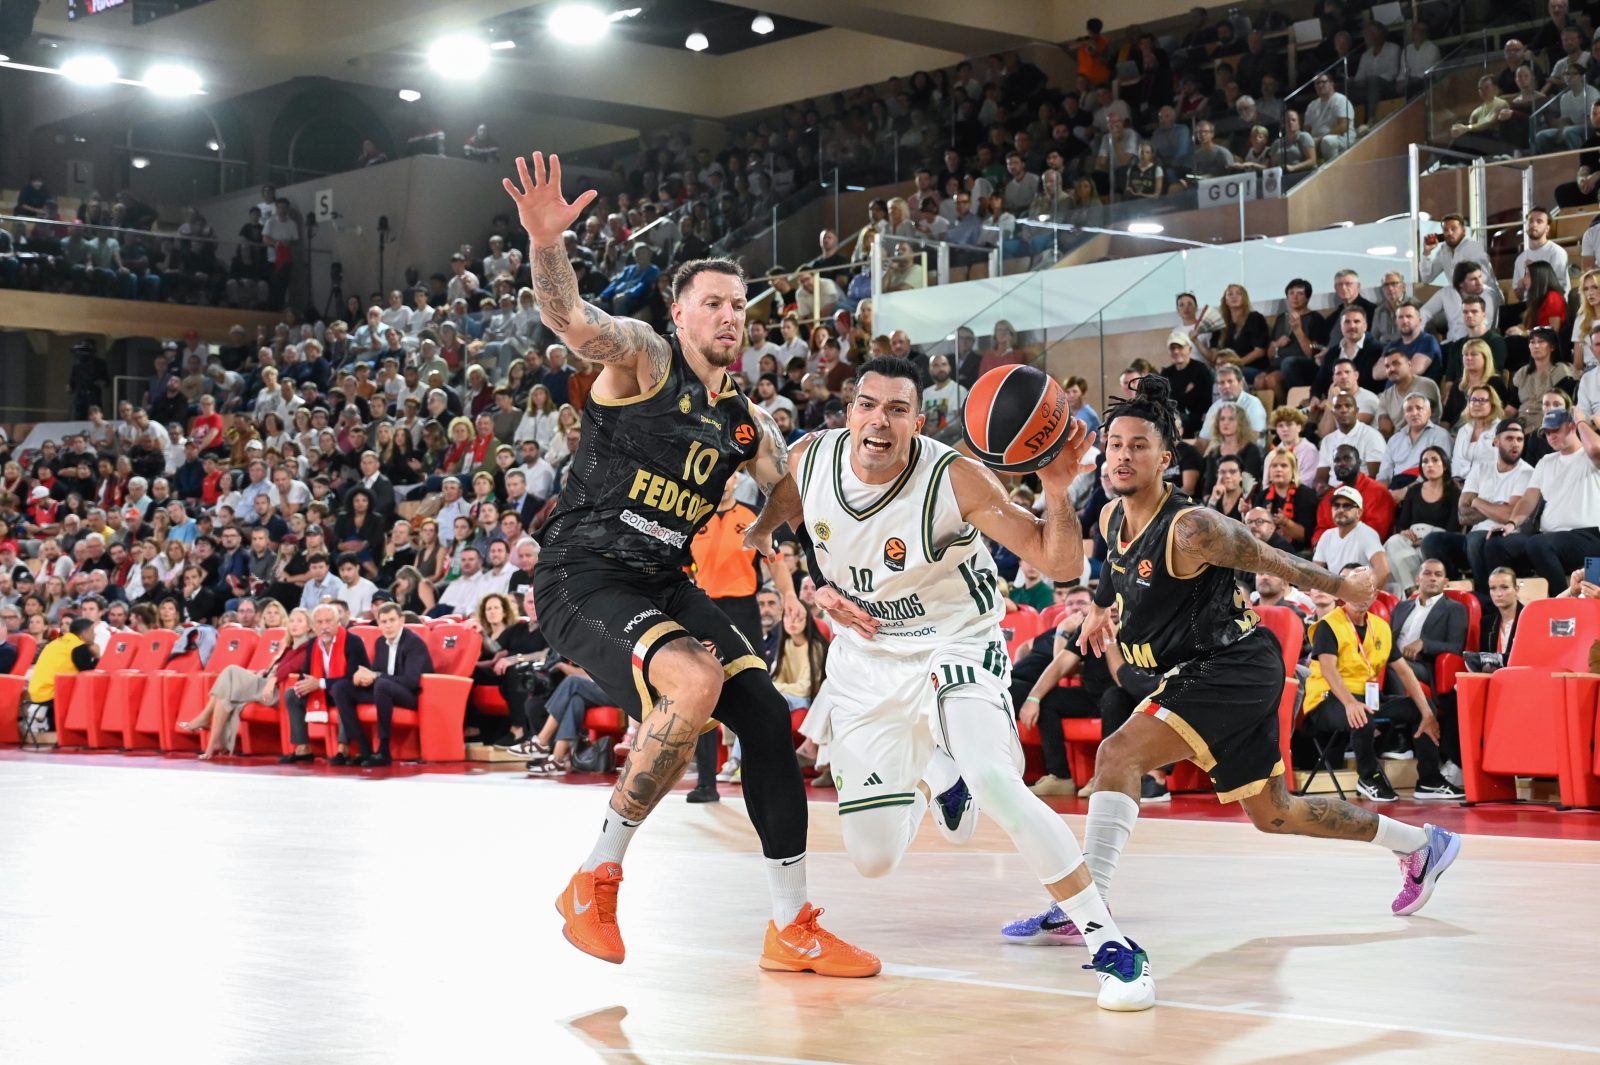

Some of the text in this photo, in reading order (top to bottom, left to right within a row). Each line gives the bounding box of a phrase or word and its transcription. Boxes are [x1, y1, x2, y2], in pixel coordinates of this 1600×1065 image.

[320, 195, 329, 216] S
[682, 440, 720, 485] 10
[848, 565, 874, 593] 10
